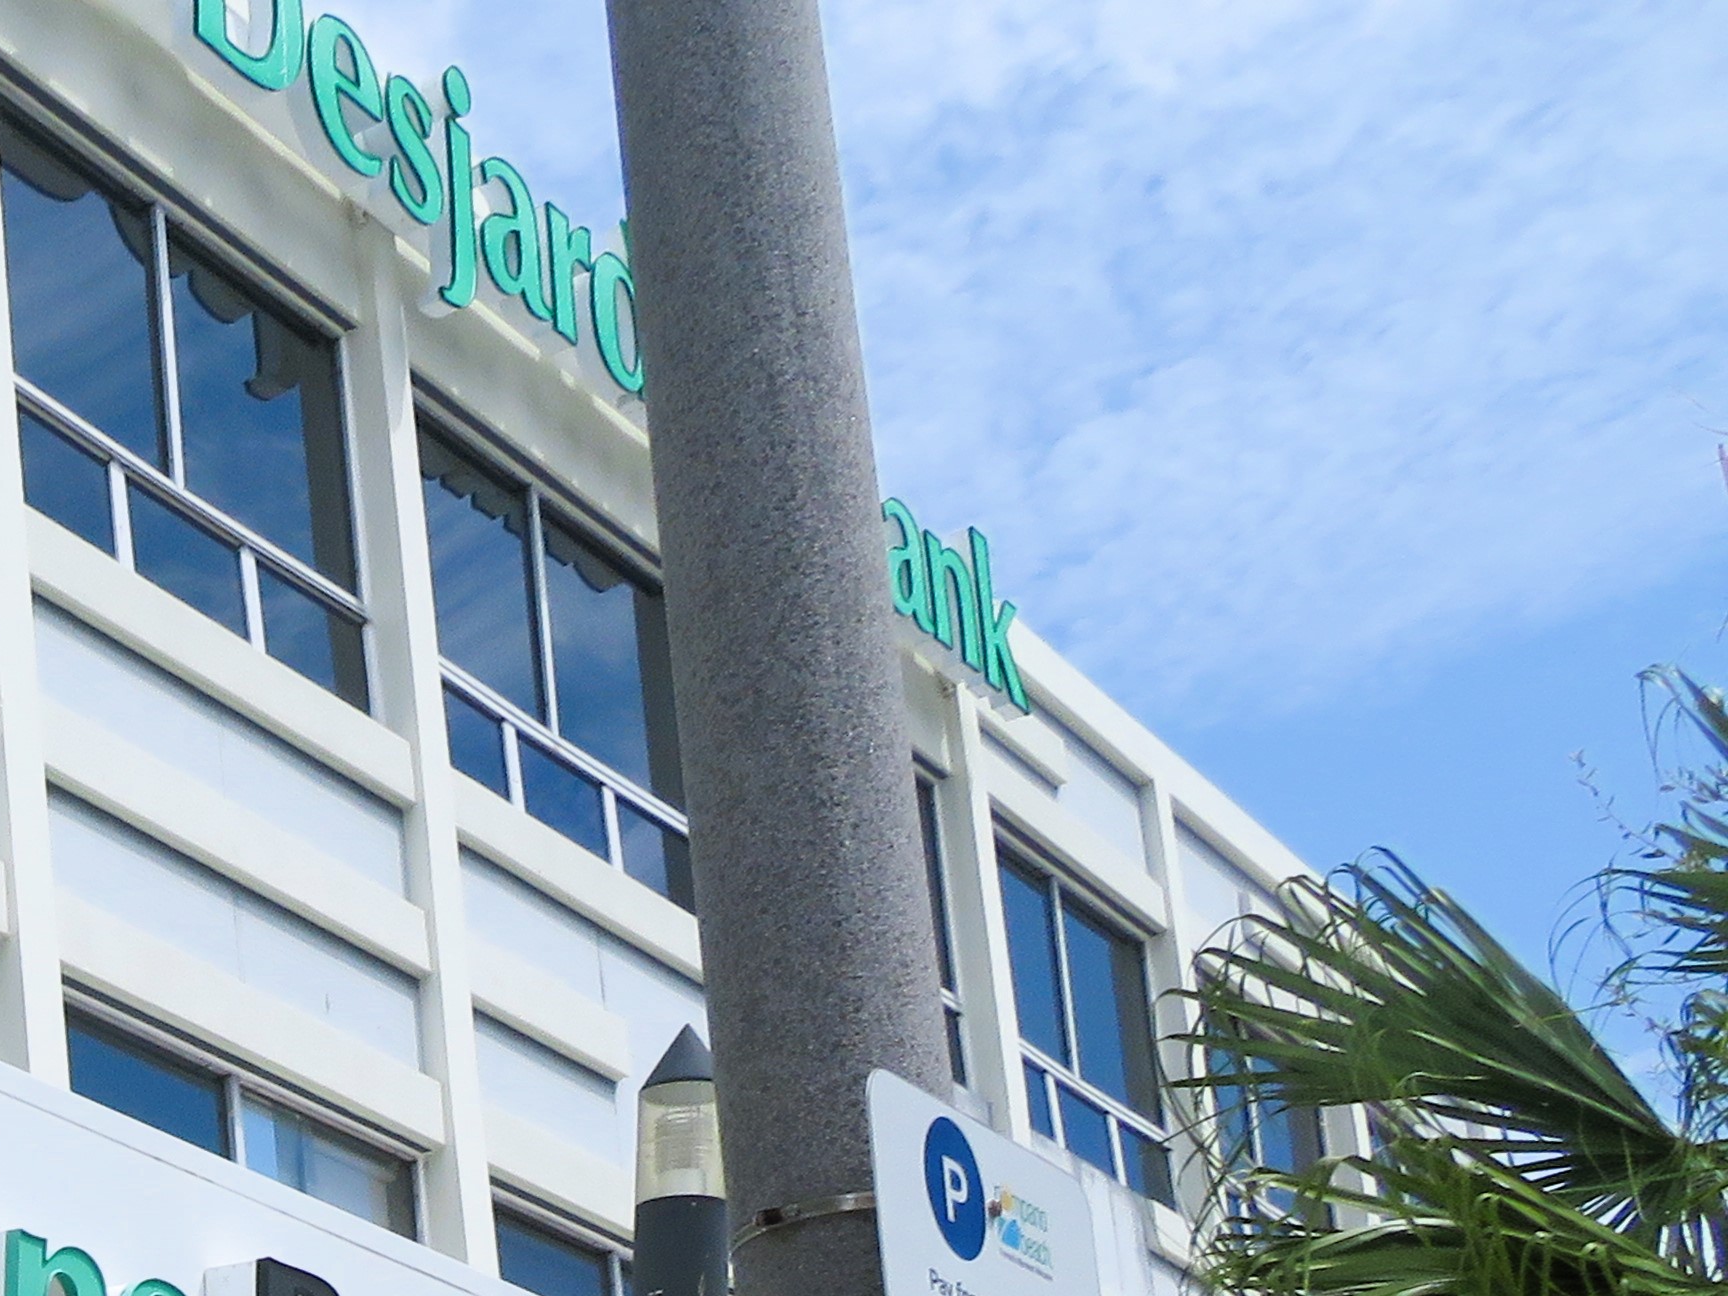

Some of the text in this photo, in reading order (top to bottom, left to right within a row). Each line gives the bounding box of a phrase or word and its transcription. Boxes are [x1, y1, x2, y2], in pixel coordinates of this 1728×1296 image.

[194, 0, 1031, 716] esjard ank
[942, 1154, 968, 1223] P
